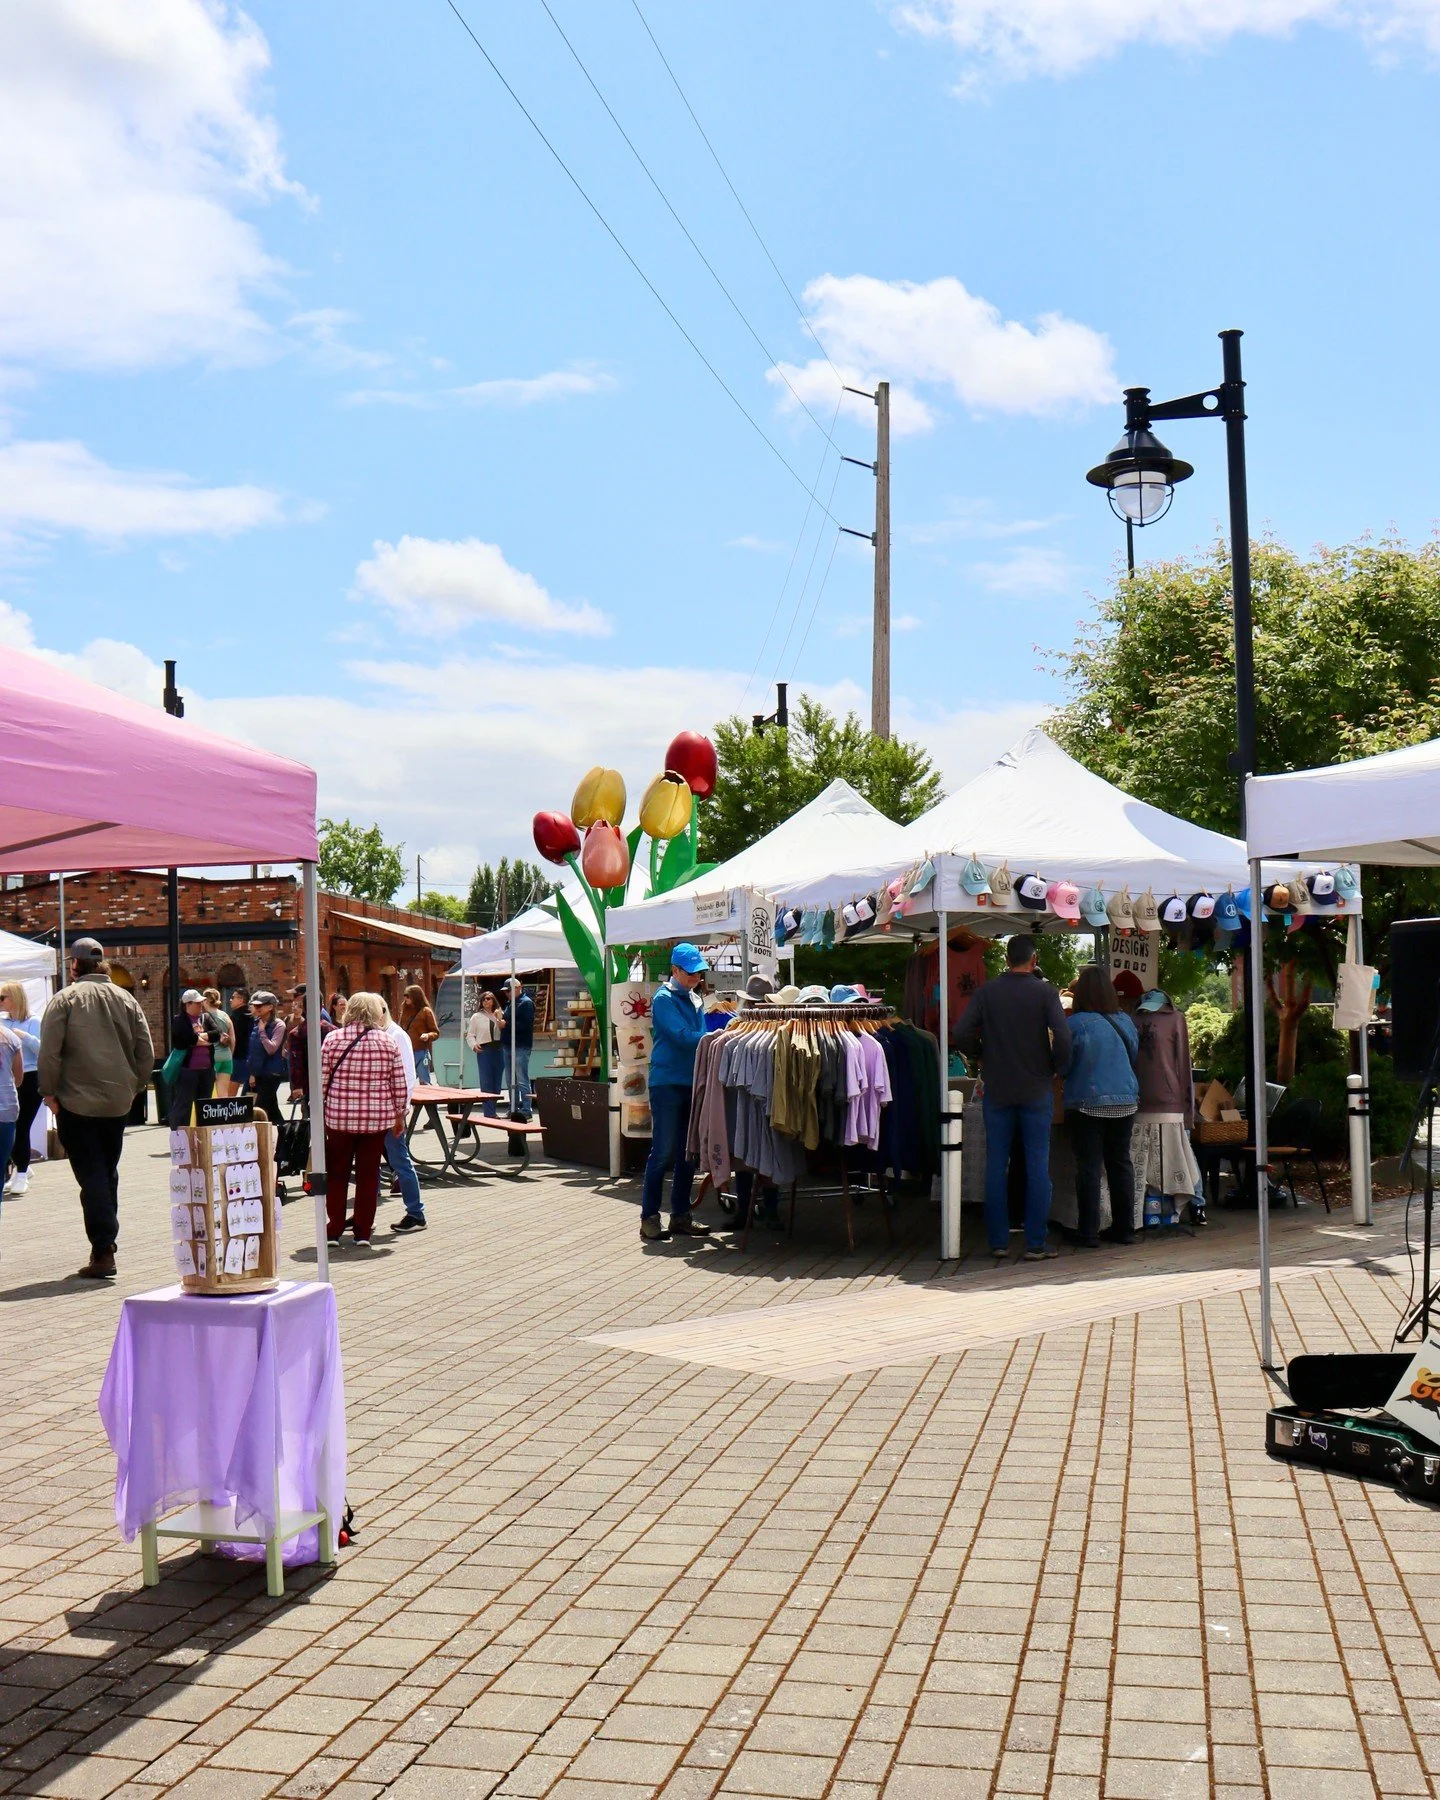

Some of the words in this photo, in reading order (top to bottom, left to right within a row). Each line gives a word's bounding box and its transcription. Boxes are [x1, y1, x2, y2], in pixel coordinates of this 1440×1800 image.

[754, 947, 772, 958] BOOTH
[1112, 938, 1149, 958] DESIGNS
[202, 1104, 228, 1121] Sterling
[228, 1101, 248, 1117] Silver
